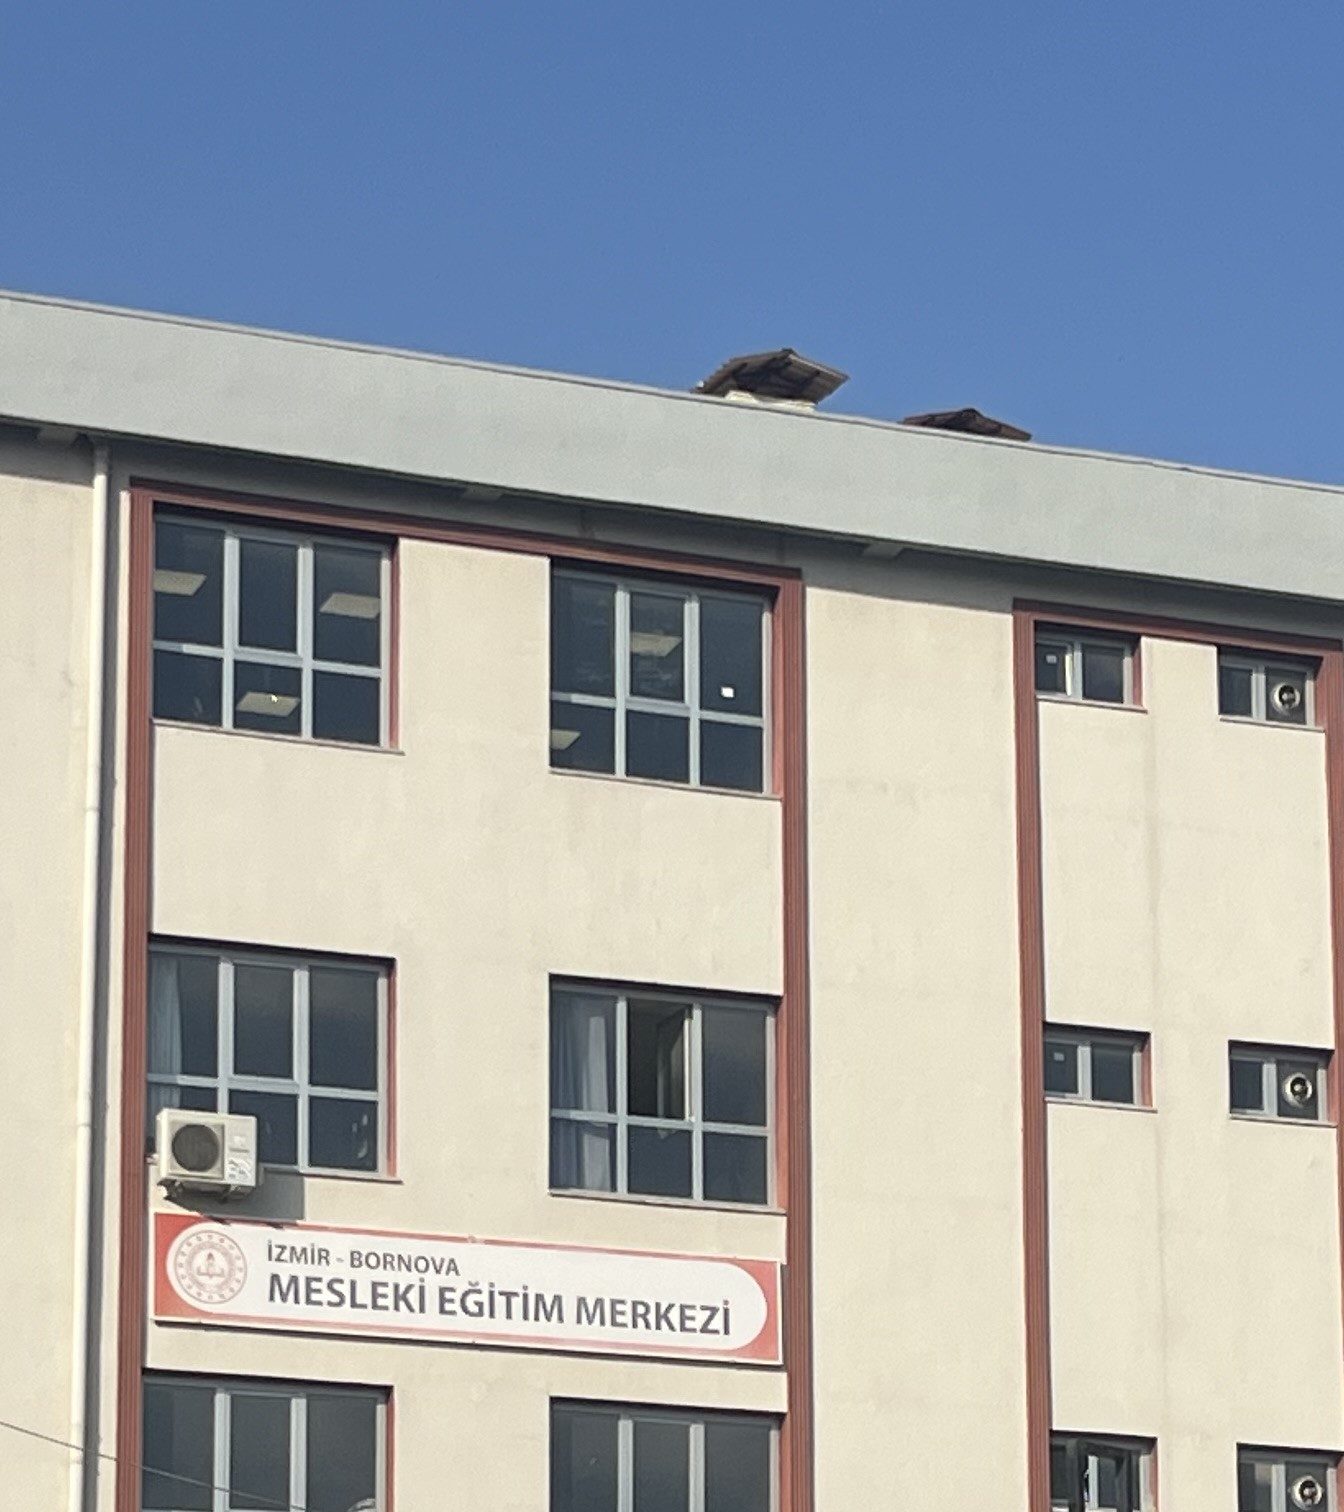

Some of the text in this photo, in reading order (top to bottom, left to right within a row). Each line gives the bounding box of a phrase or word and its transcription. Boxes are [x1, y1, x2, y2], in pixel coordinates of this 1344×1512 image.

[267, 1240, 331, 1268] İZMİR
[349, 1250, 461, 1278] BORNOVA
[267, 1273, 731, 1337] MESLEKİ EĞİTİM MERKEZİ
